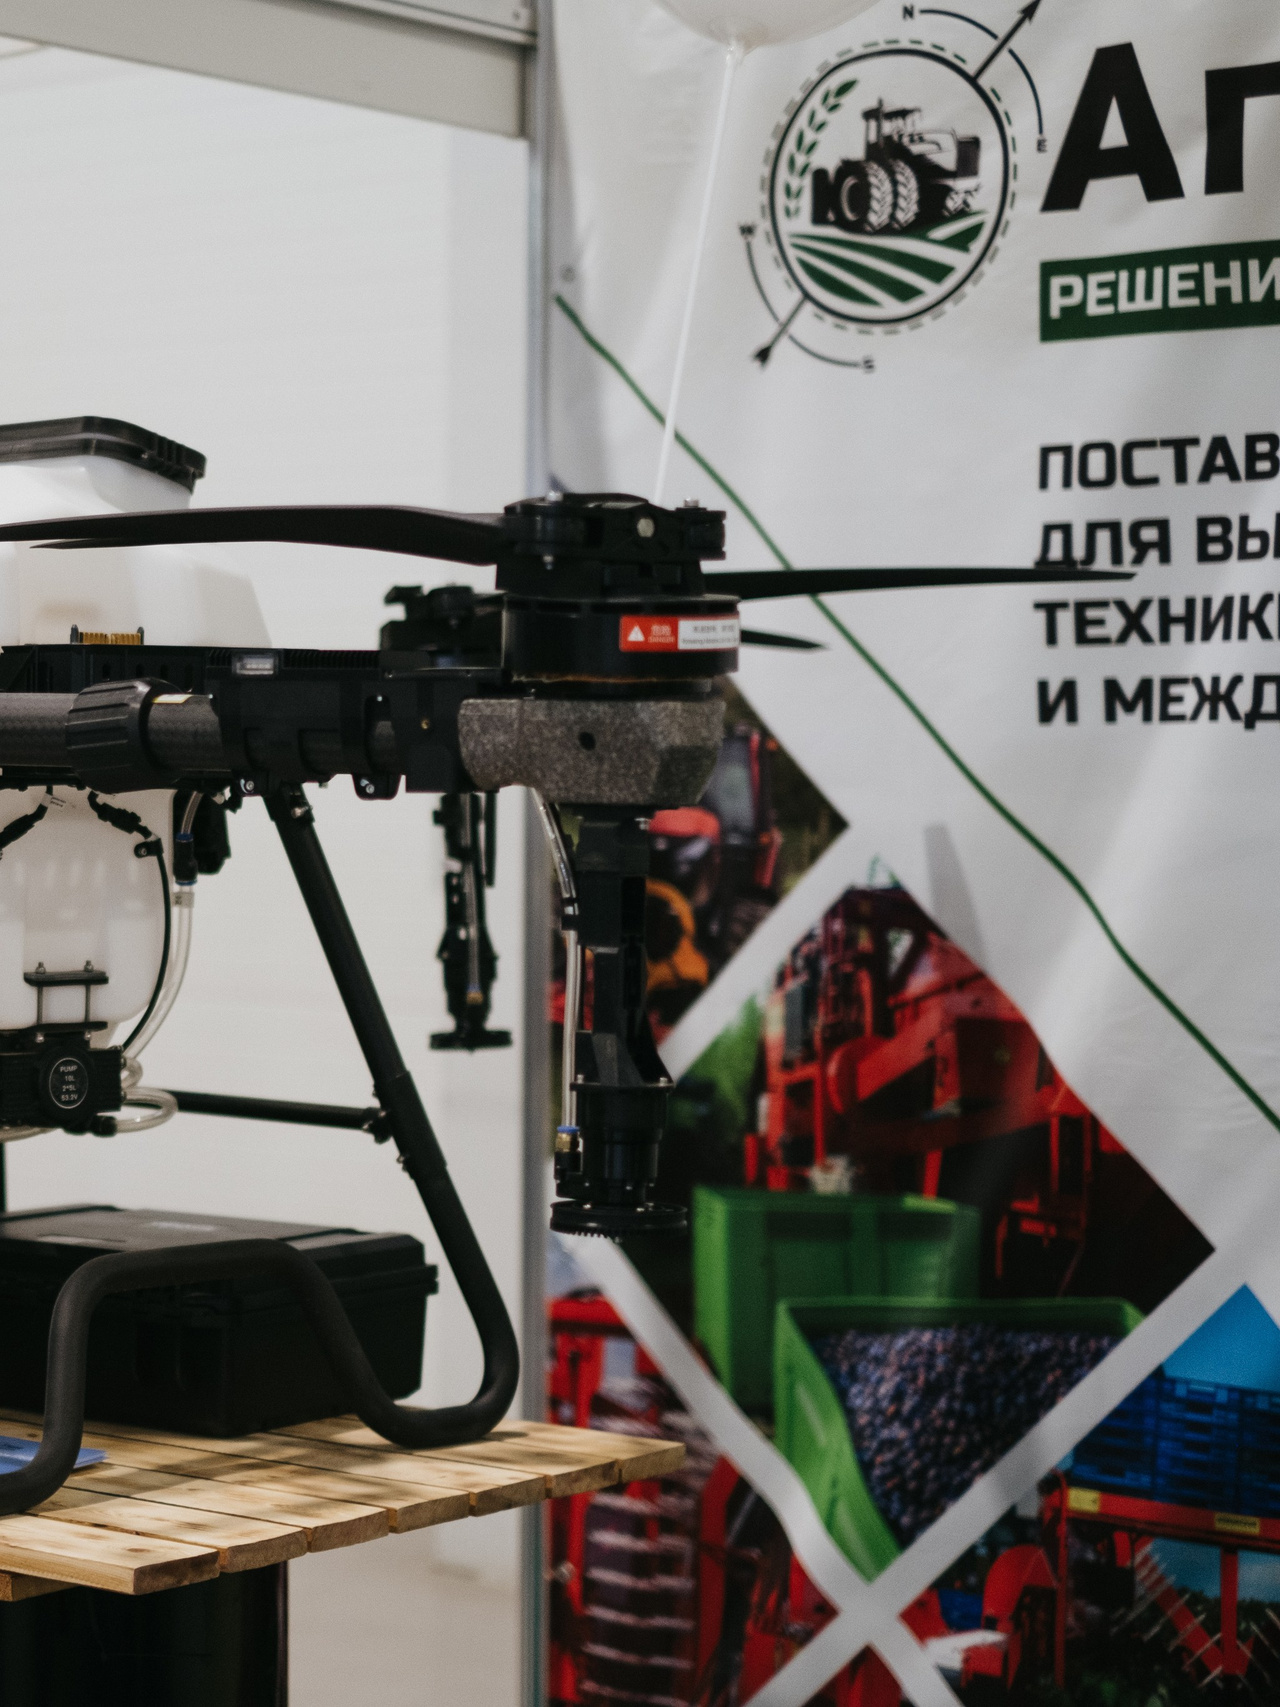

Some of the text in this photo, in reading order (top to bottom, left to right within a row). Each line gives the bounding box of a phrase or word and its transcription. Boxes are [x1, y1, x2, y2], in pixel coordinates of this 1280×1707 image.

[902, 5, 915, 19] N
[1049, 257, 1280, 319] РЕШЕНИ
[1038, 432, 1280, 490] ПОСТАВ
[1034, 517, 1171, 571] ДЛЯ
[1033, 592, 1280, 647] ТЕХНИК
[1037, 673, 1280, 730] И МЕЖД
